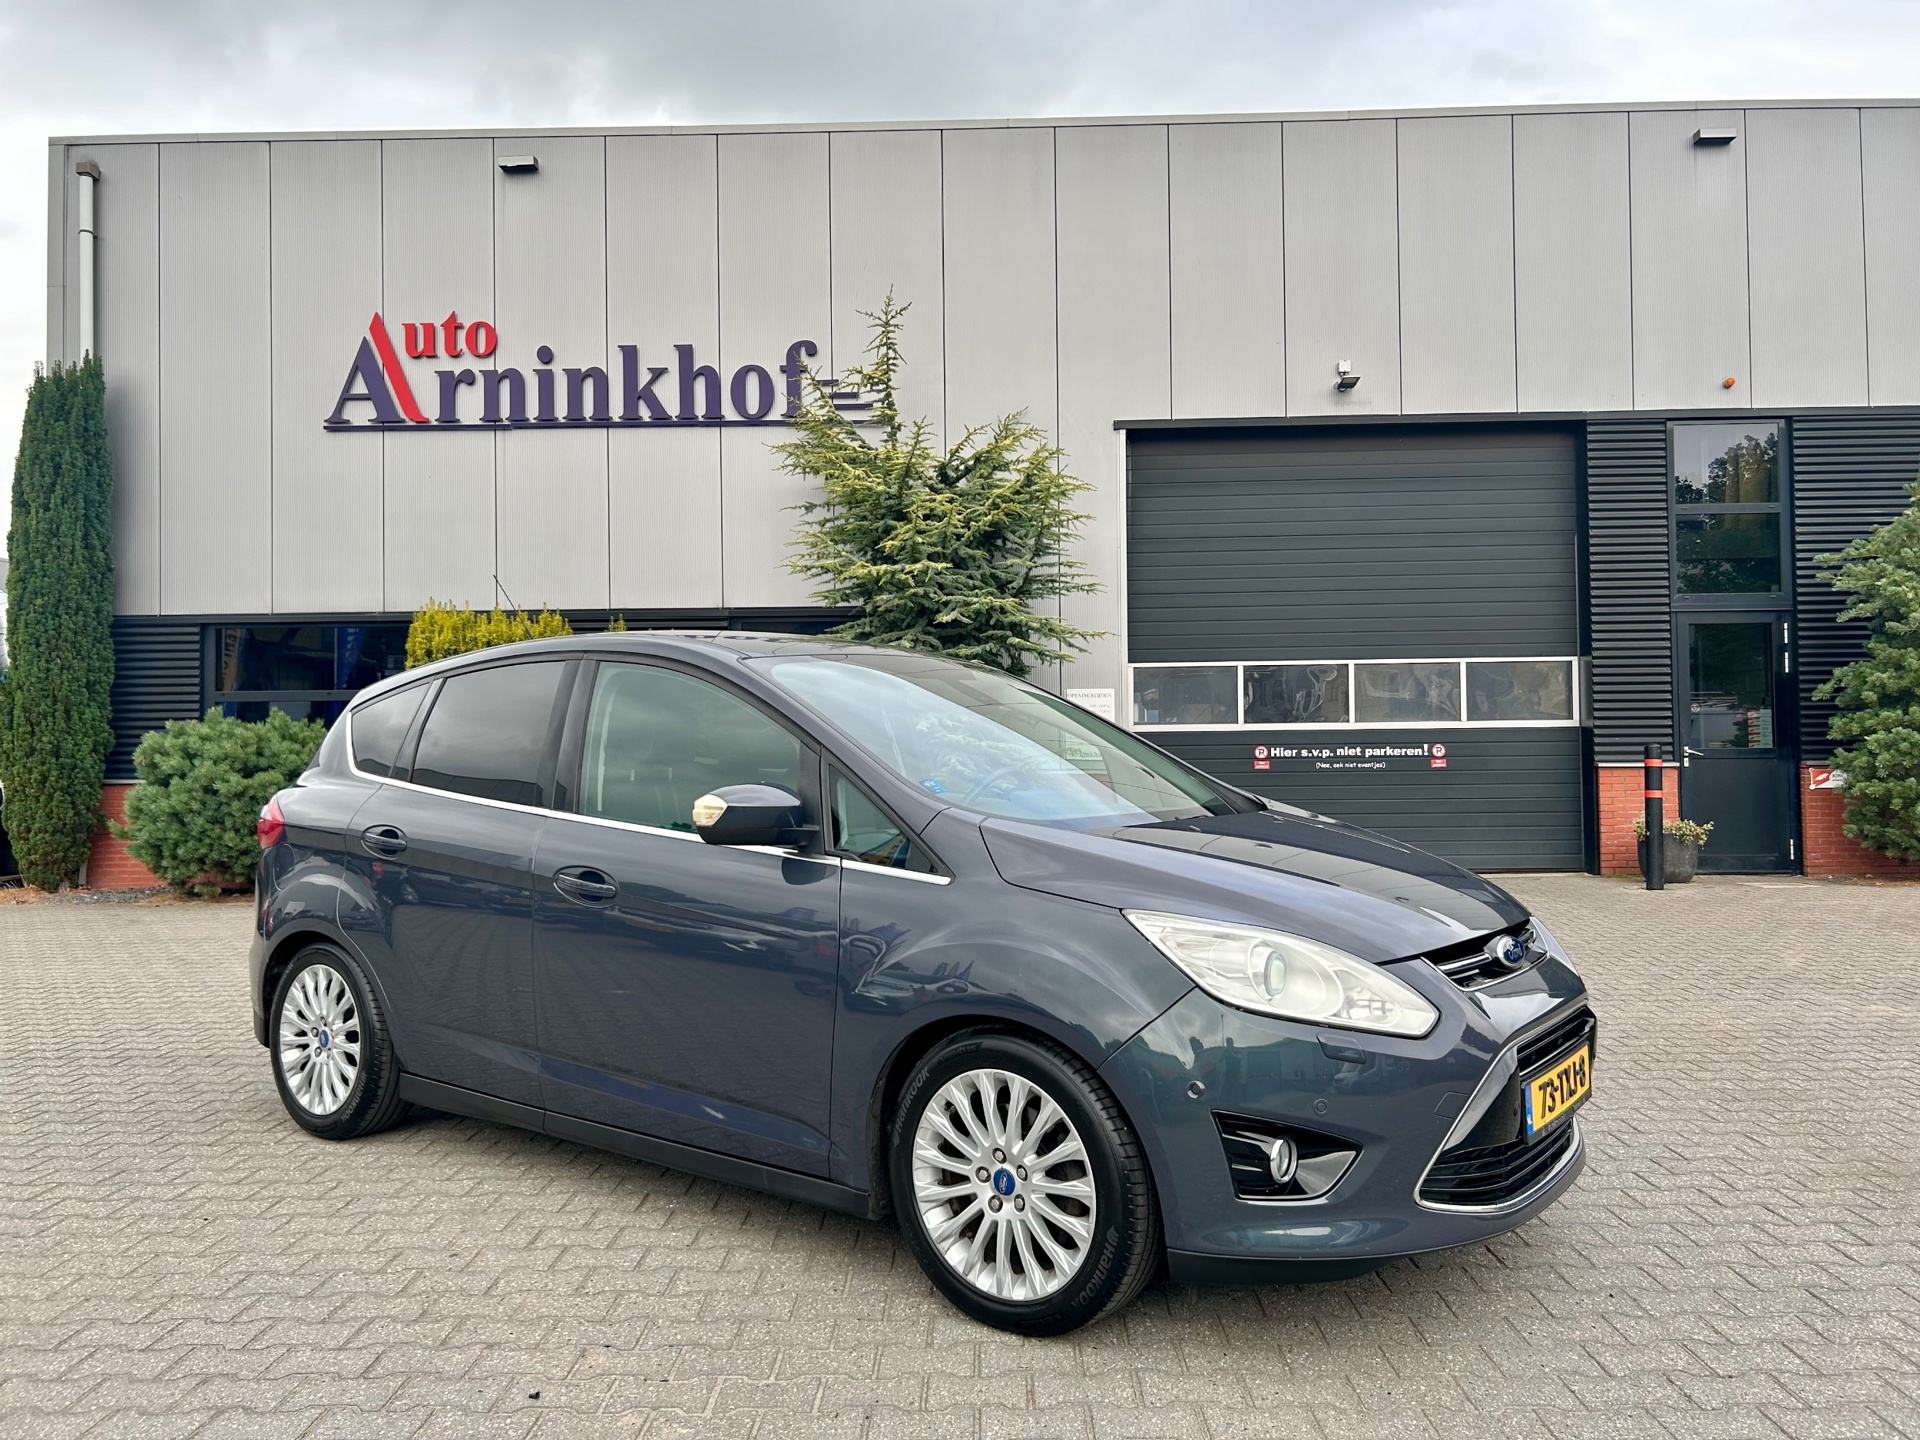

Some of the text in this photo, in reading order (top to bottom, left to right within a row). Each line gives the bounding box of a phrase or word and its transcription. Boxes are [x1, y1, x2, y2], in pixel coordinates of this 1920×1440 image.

[324, 311, 818, 423] Arninkhof
[1270, 744, 1429, 758] Hier s.v.p. niet parkeren!
